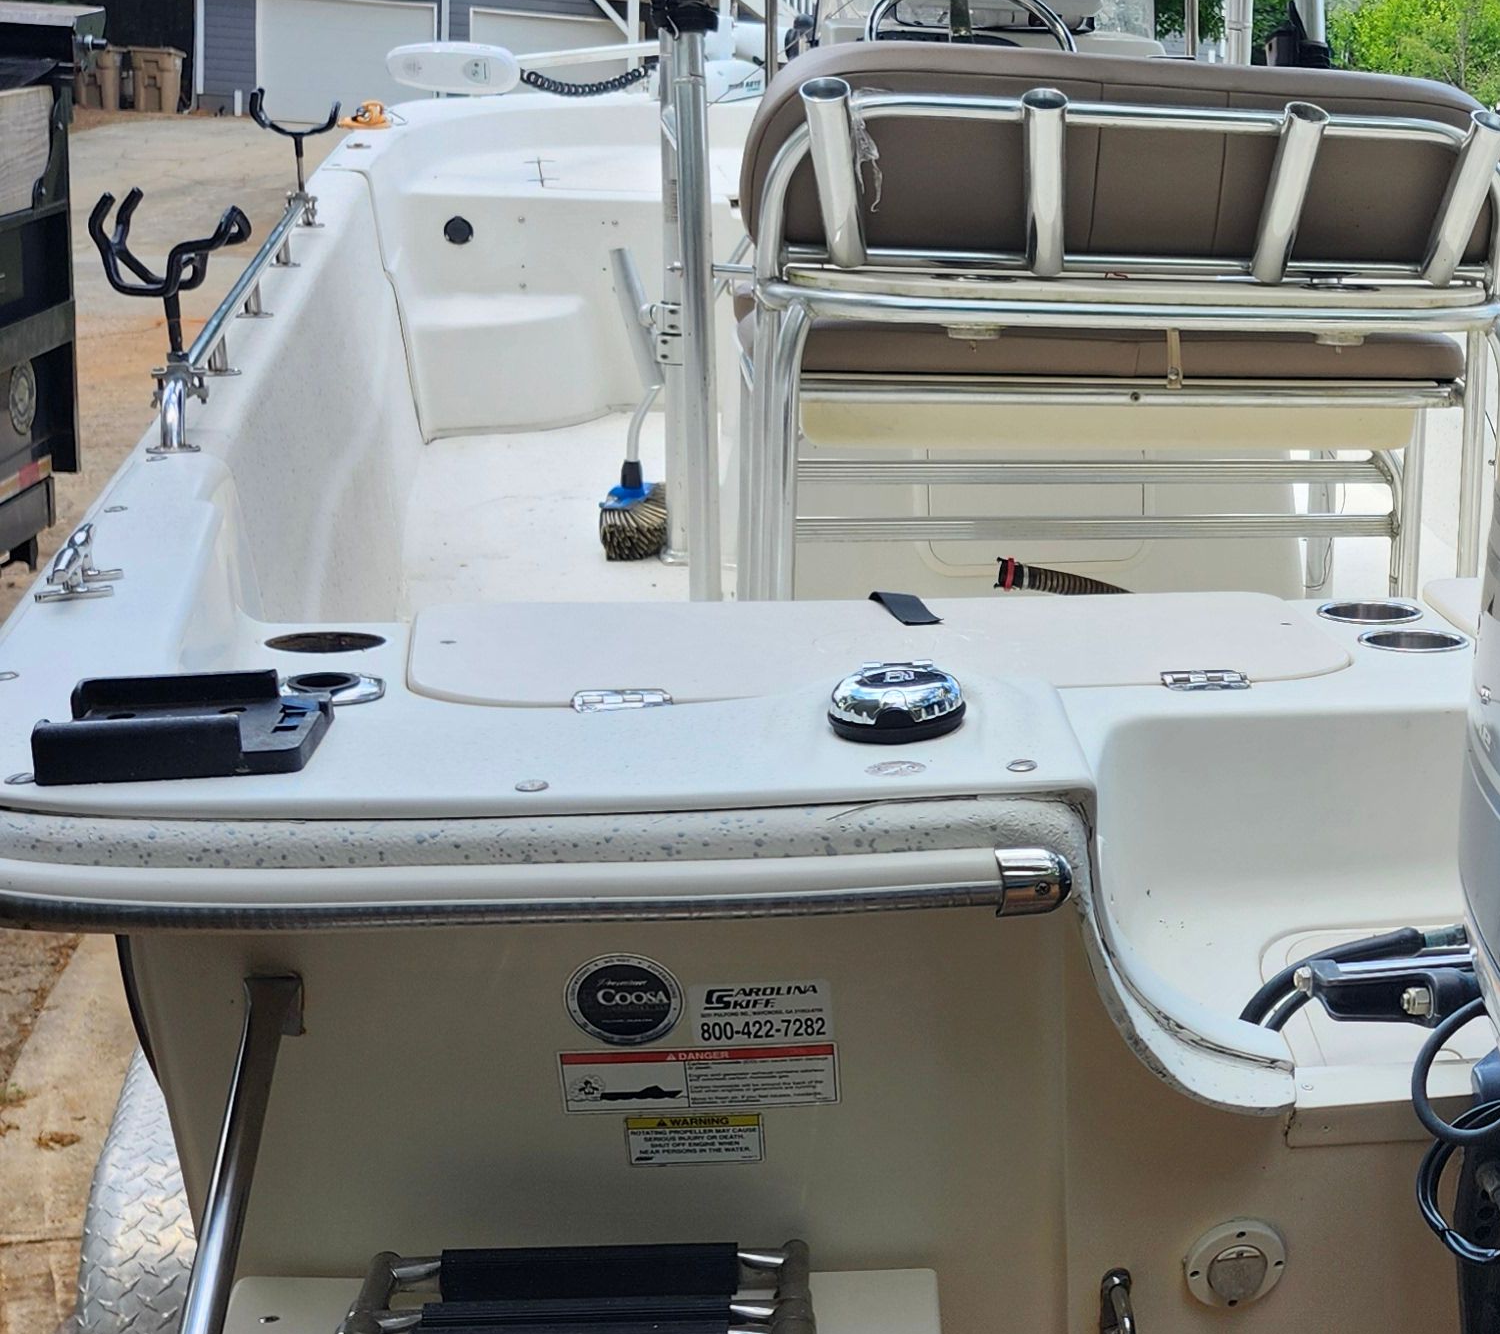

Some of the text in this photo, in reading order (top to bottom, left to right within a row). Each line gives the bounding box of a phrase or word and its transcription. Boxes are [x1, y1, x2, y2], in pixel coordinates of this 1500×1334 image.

[596, 988, 671, 1006] COOSA
[700, 1017, 827, 1041] 800-422-7282
[678, 1050, 730, 1061] DANGER
[670, 1116, 730, 1127] WARNING
